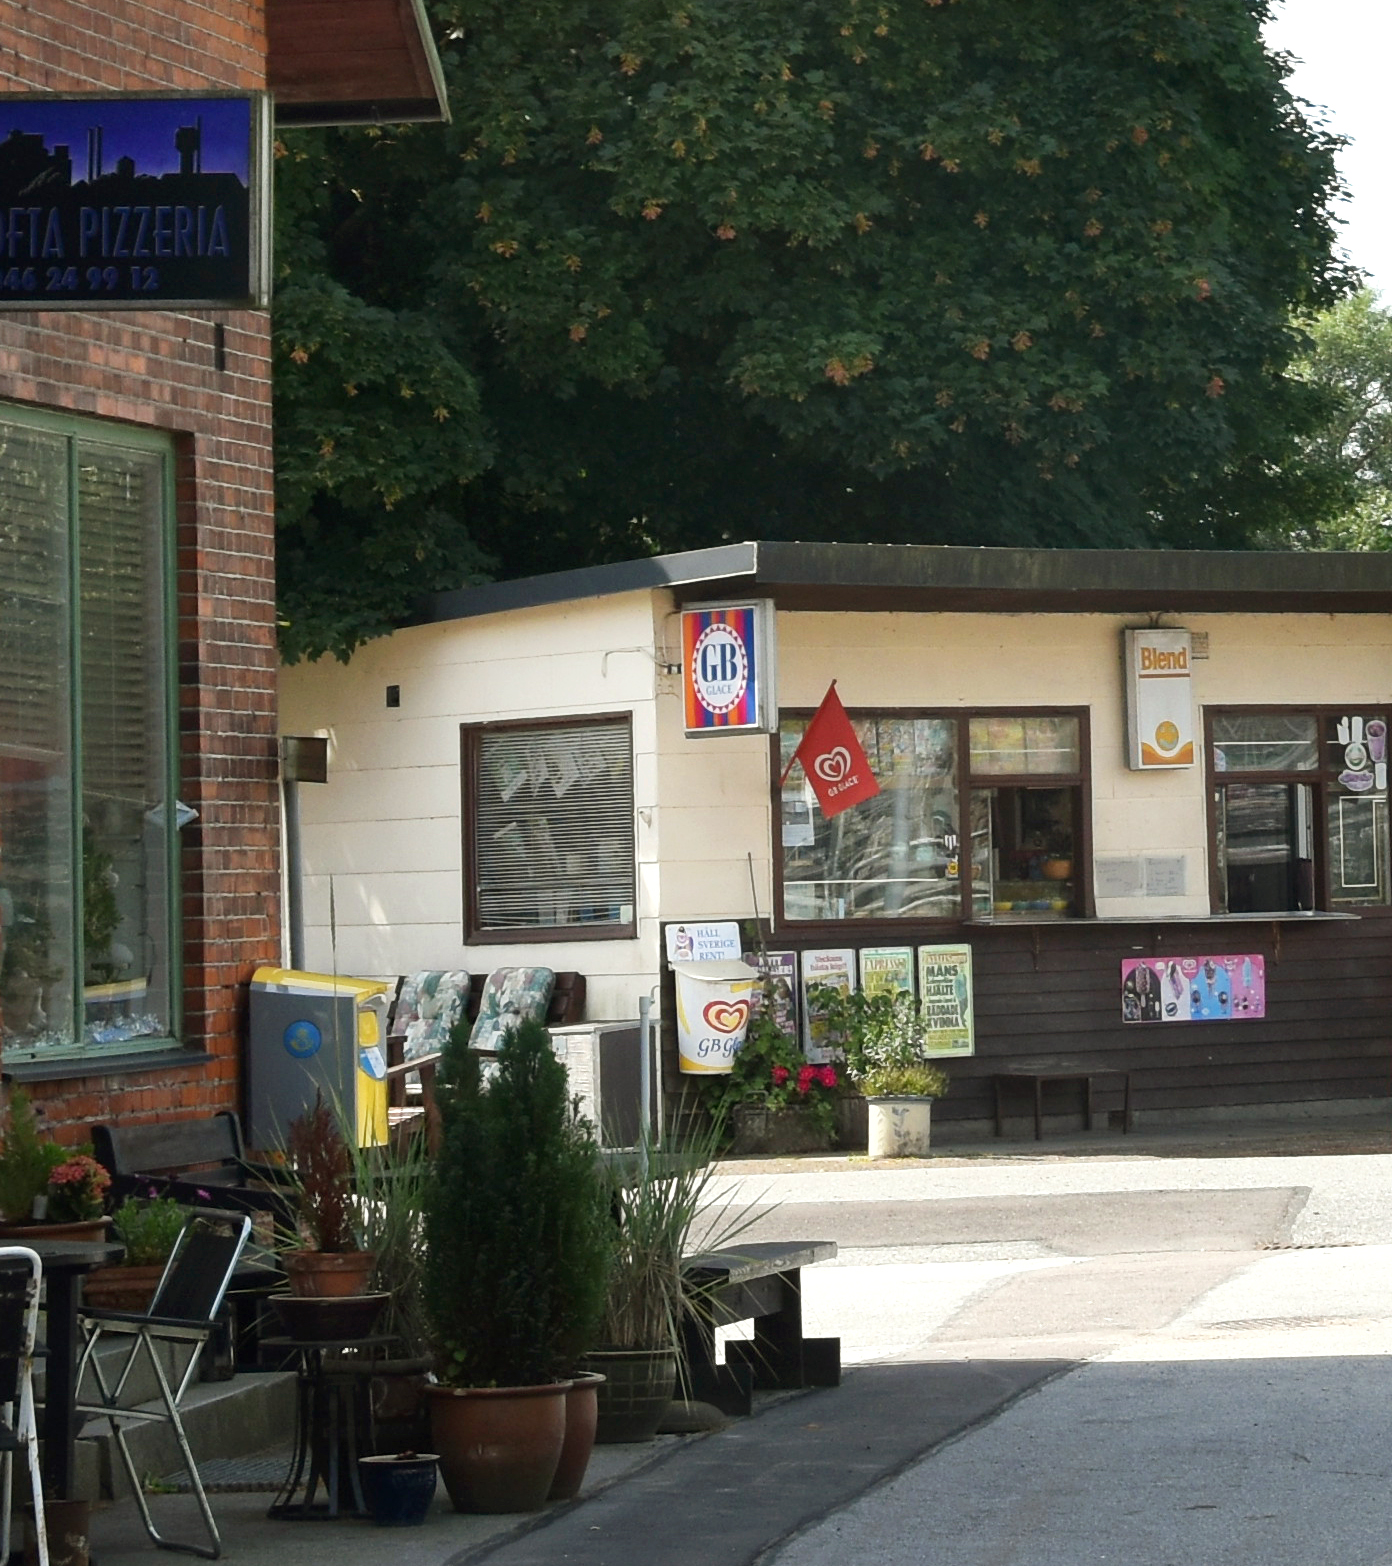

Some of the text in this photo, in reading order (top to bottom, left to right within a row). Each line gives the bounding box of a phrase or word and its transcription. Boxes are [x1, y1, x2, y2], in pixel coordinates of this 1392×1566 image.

[79, 204, 231, 258] PIZZERIA
[0, 266, 160, 291] 46 24 99 12
[700, 642, 738, 683] GB
[1140, 647, 1188, 671] Blend
[705, 684, 733, 696] GLACE
[697, 926, 720, 937] HÅLL
[697, 939, 736, 949] SVERIGE
[697, 1038, 721, 1058] GB
